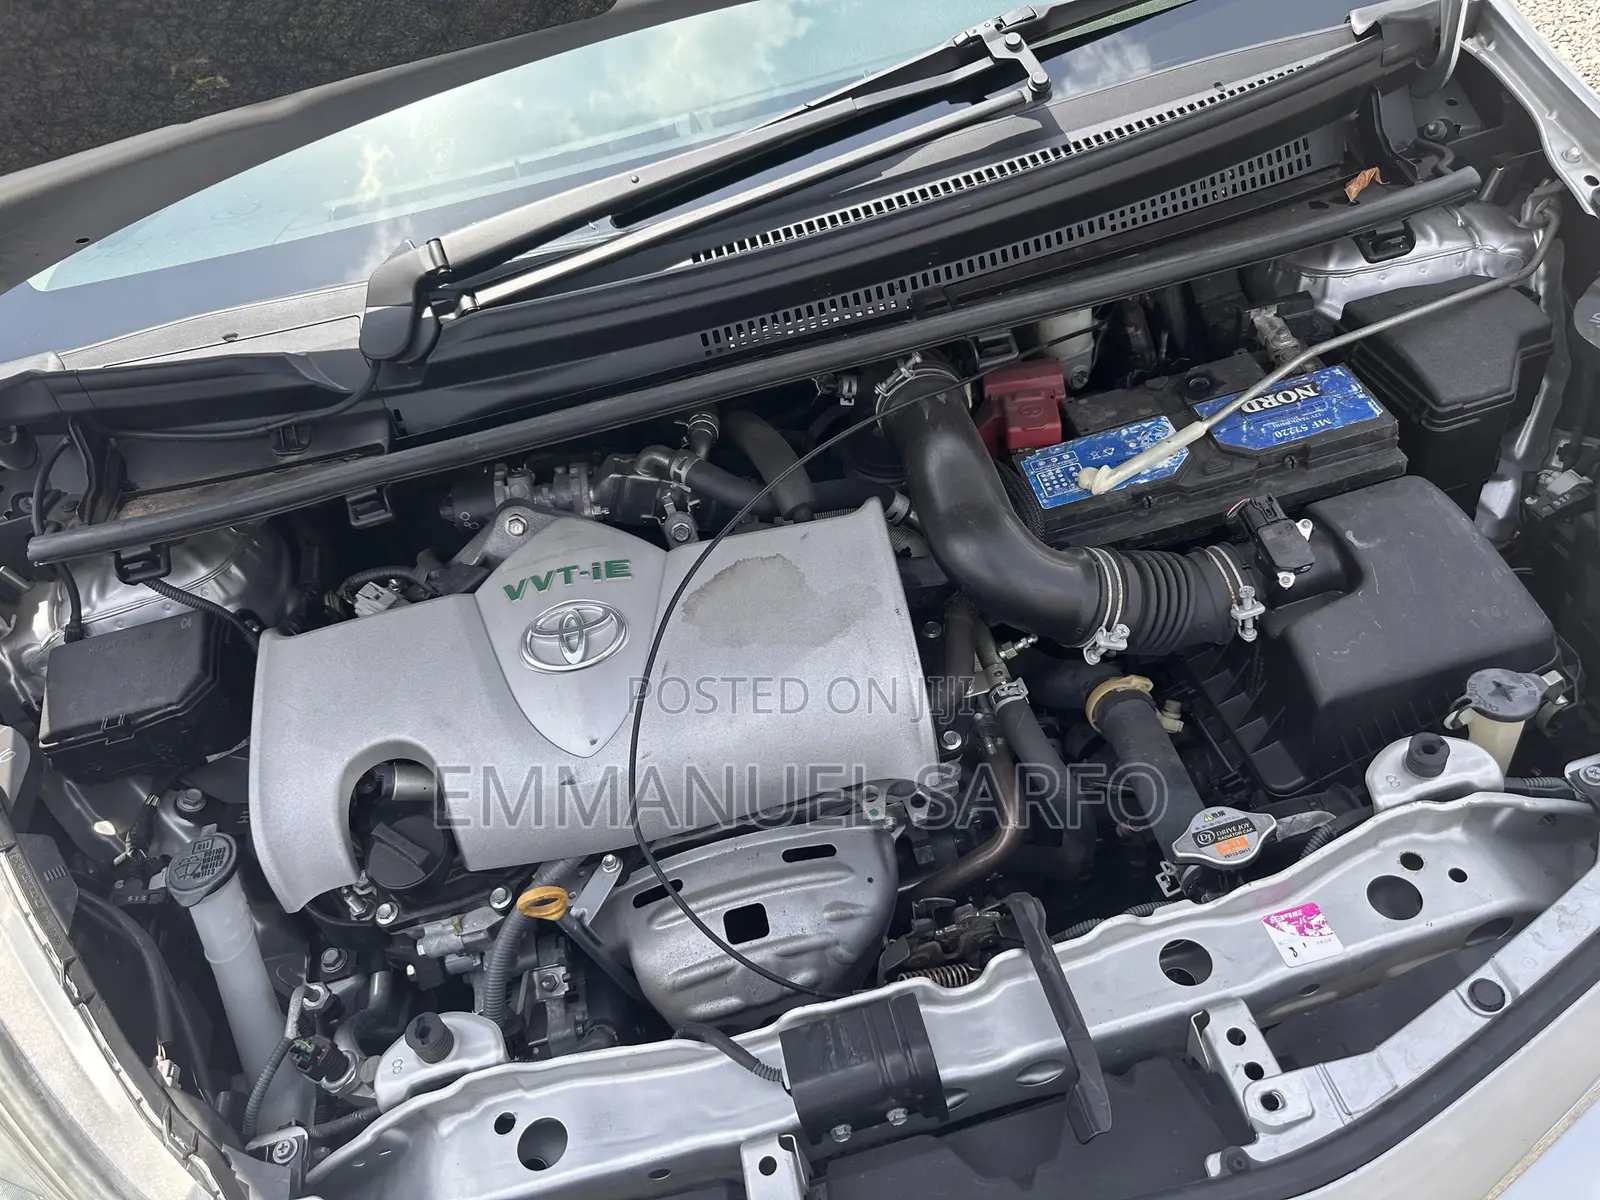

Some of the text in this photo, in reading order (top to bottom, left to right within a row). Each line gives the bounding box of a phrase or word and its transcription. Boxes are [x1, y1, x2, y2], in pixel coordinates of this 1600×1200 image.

[1241, 384, 1320, 413] NORD
[1274, 417, 1332, 438] MF 57220
[502, 559, 632, 602] VVT-iE
[1216, 826, 1237, 837] DRIVE
[1238, 822, 1250, 832] JOY
